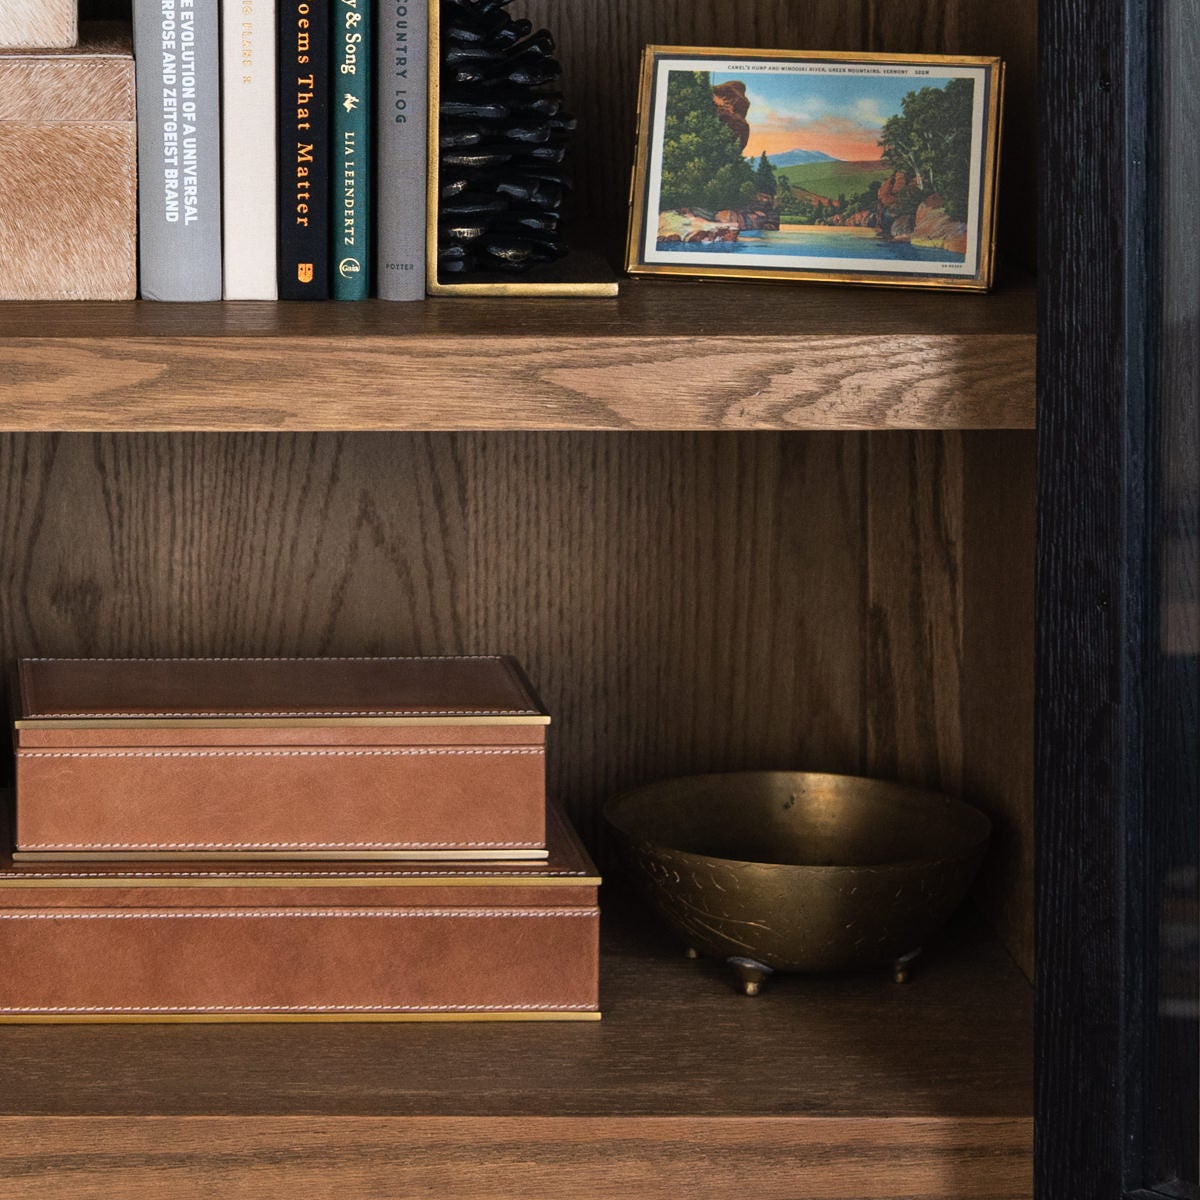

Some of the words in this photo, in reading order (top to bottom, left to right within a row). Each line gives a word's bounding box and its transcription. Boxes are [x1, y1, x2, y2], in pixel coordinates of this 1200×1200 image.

[345, 11, 362, 29] &
[162, 52, 177, 85] AND
[181, 11, 196, 98] EVOLUTION
[340, 33, 362, 75] Song
[182, 101, 196, 122] OF
[297, 74, 315, 131] That
[395, 90, 407, 124] LOG
[163, 88, 178, 166] ZEITGEIST
[183, 123, 196, 135] A
[344, 132, 355, 155] LIA
[164, 168, 179, 222] BRAND
[183, 138, 198, 226] UNIVERSAL
[296, 142, 314, 227] Matter
[344, 162, 355, 245] LEENDERTZ
